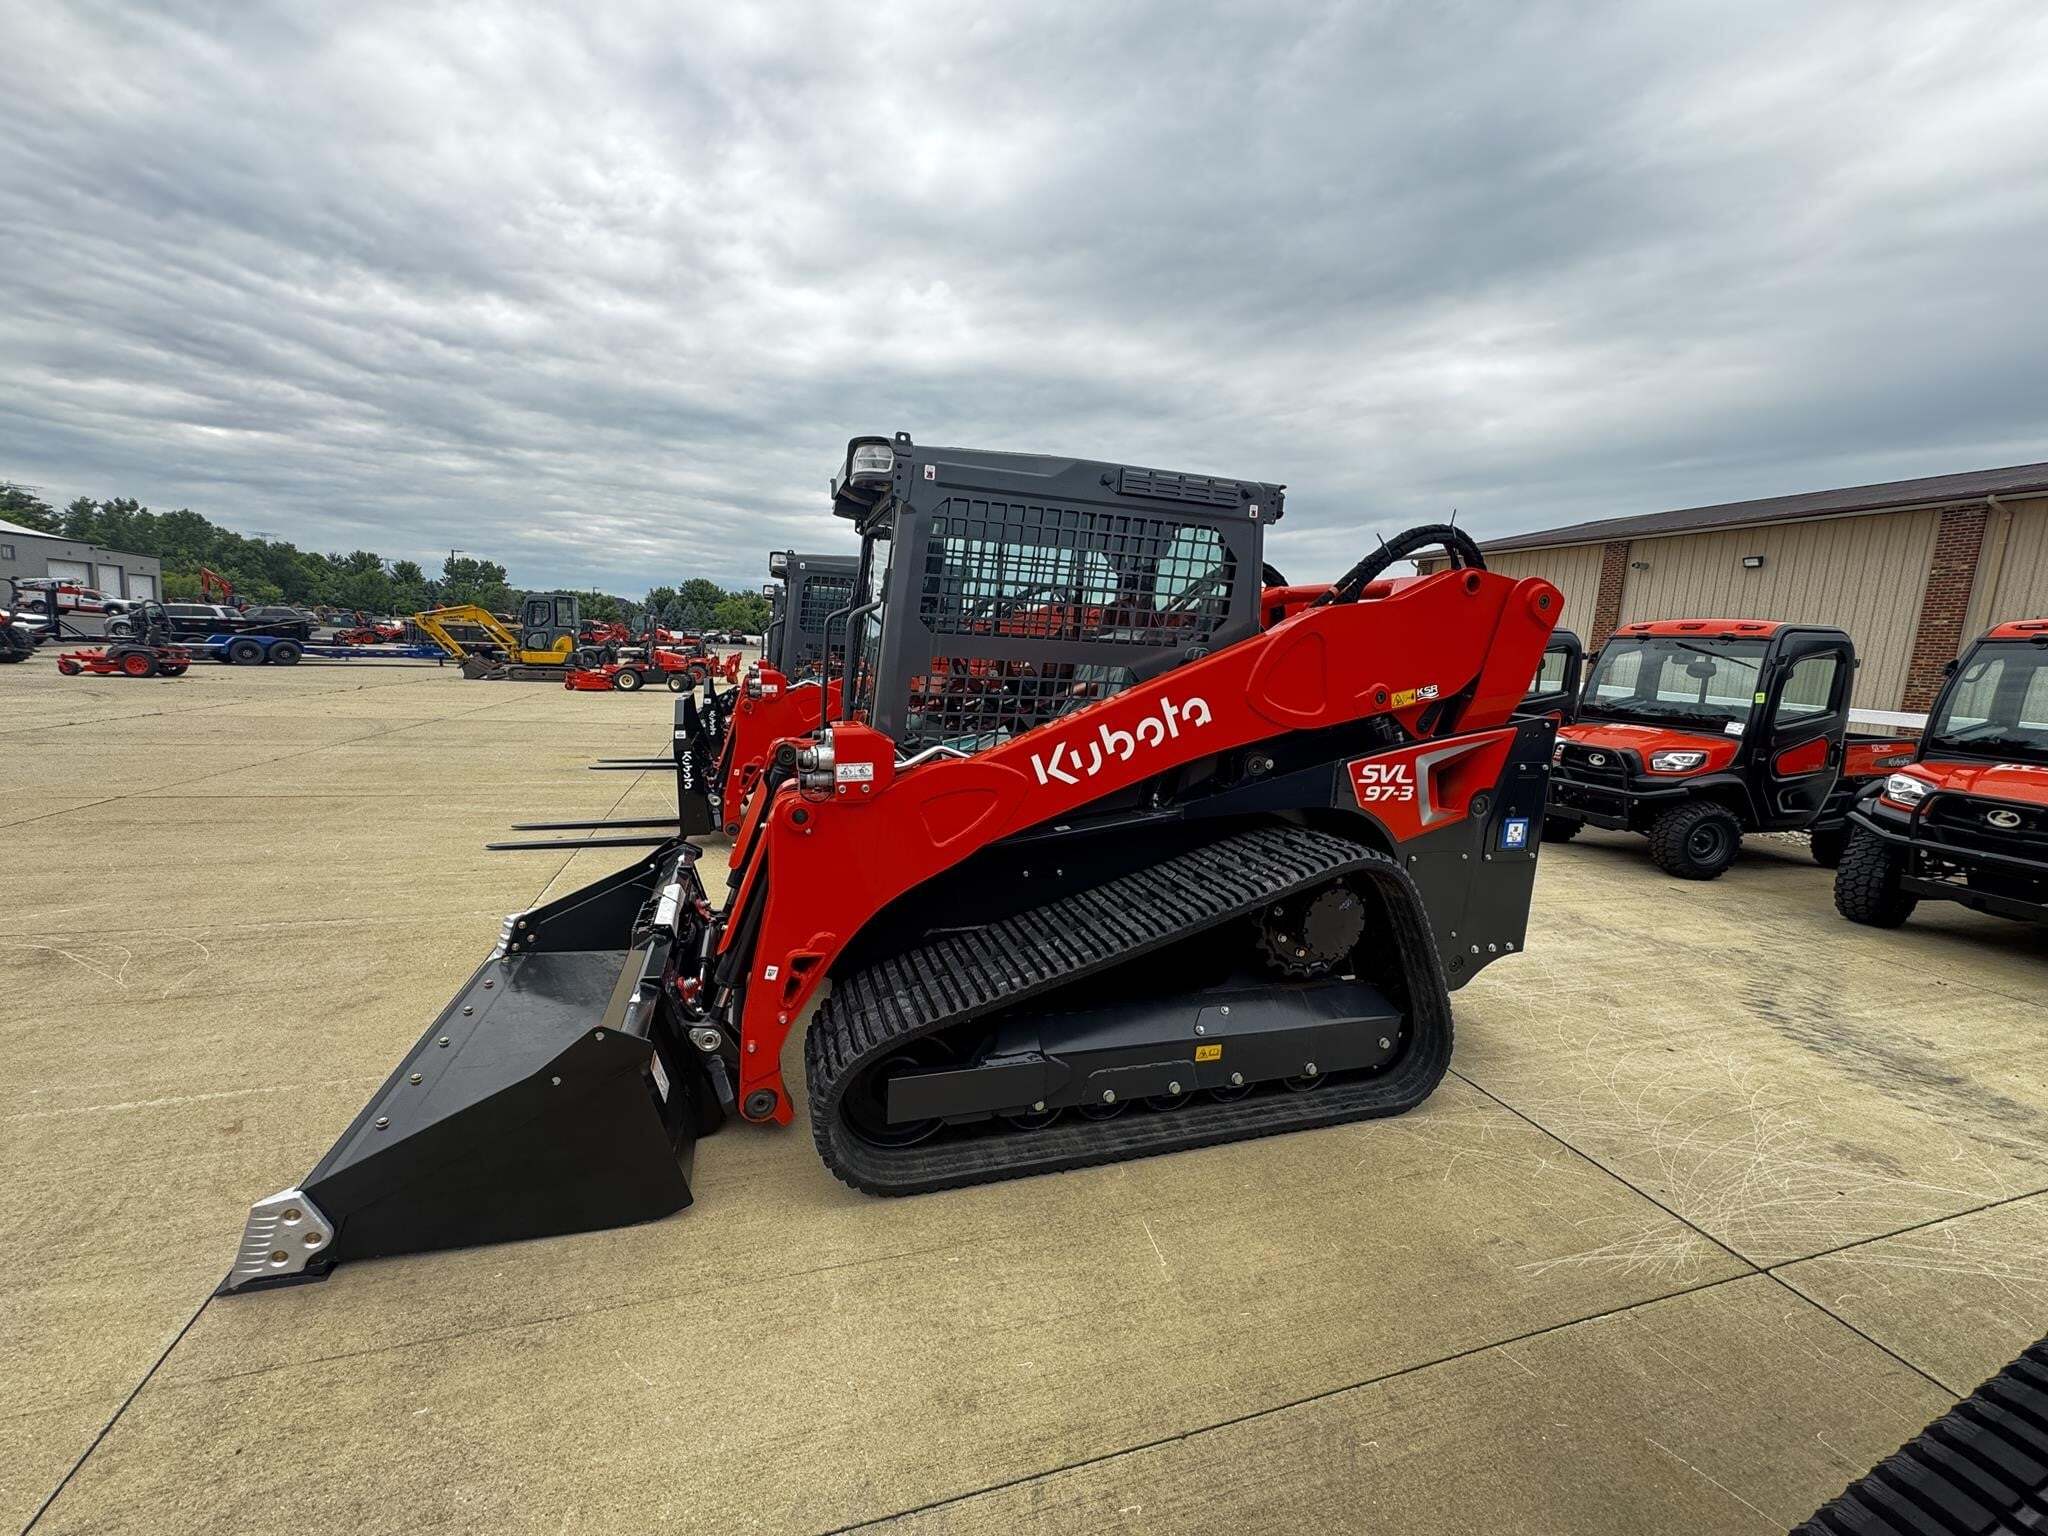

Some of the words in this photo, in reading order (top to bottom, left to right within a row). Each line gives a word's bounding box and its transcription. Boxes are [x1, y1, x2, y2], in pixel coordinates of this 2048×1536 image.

[1031, 696, 1213, 785] Kubota
[681, 751, 695, 790] Kubota
[1357, 764, 1414, 784] SVL
[1363, 786, 1415, 802] 97-3
